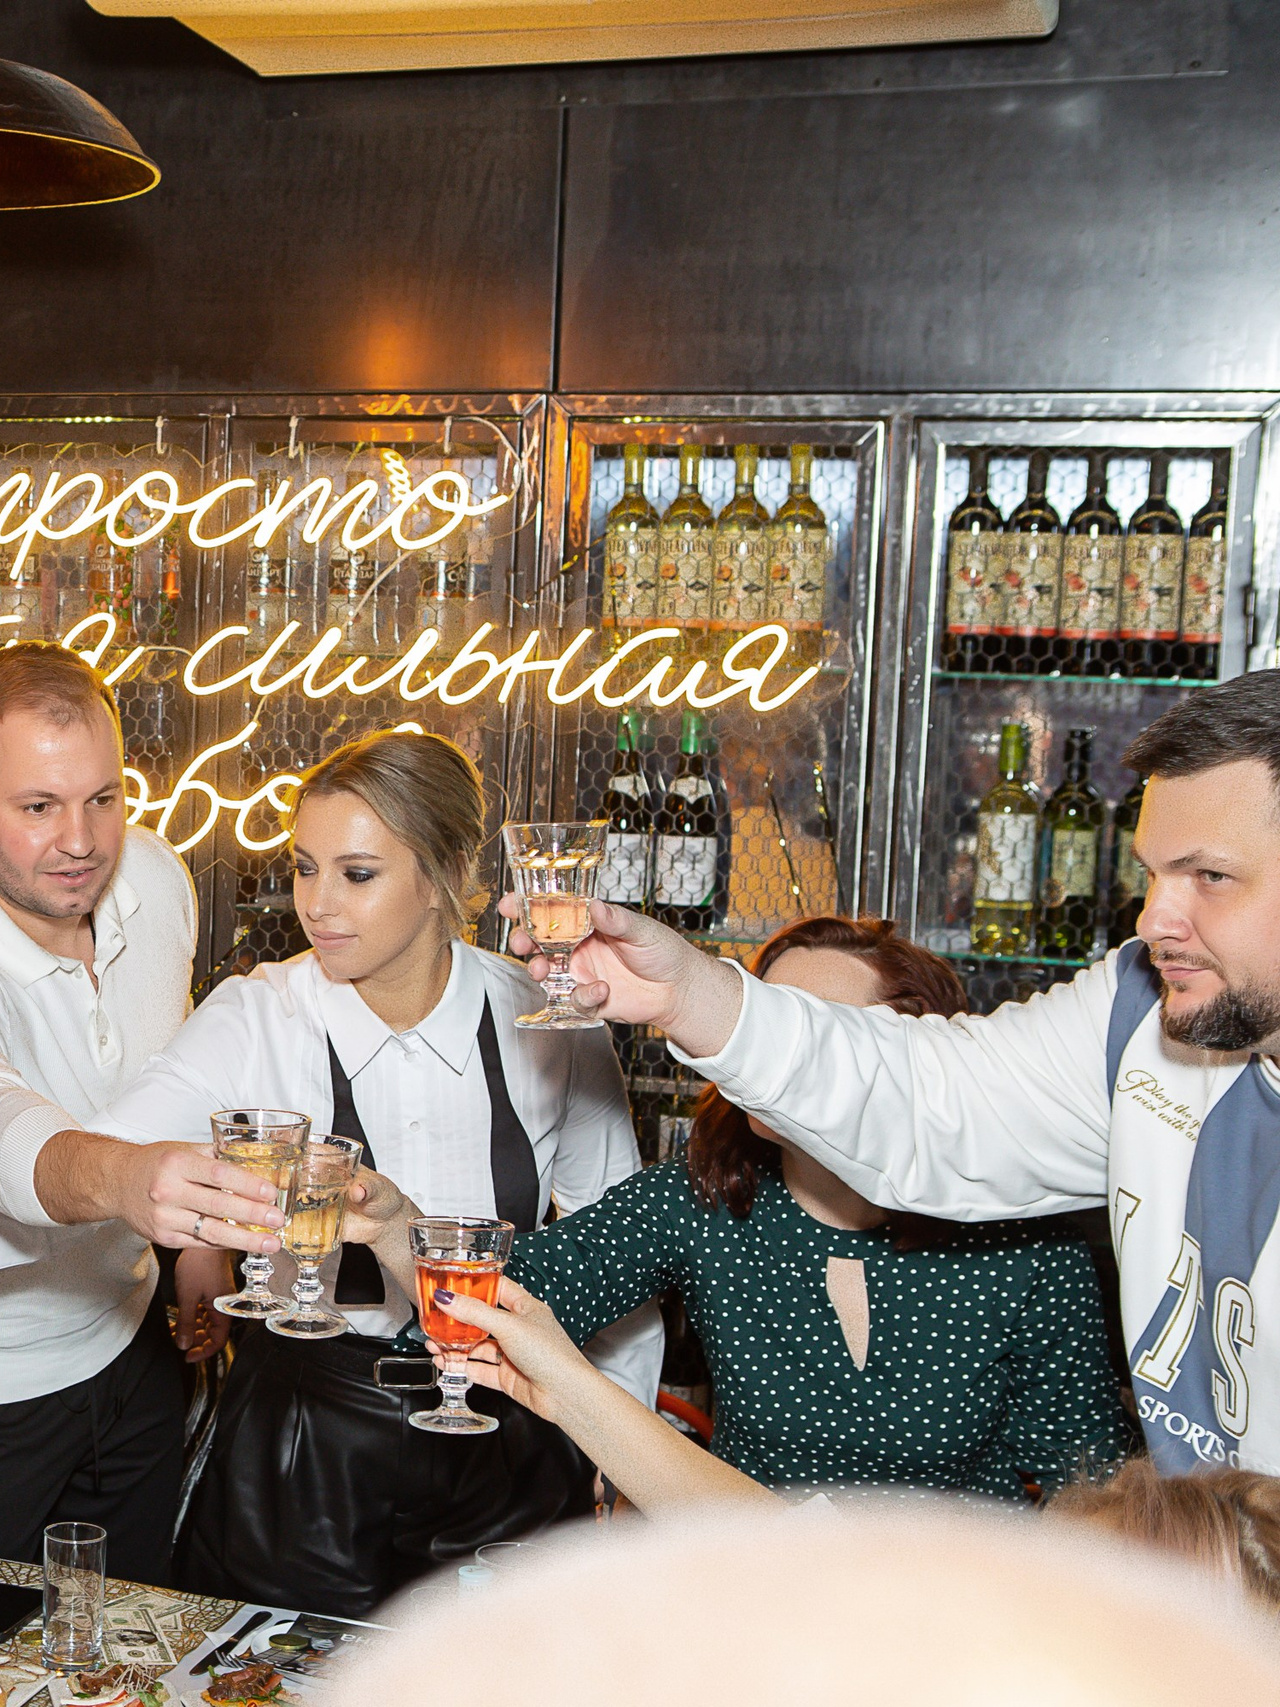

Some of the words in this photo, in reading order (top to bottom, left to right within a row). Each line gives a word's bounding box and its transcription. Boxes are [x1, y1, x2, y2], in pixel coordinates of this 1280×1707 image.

[183, 619, 821, 713] сильная
[1116, 1069, 1174, 1109] Play
[1173, 1104, 1192, 1119] the
[1137, 1394, 1226, 1463] SPORTS
